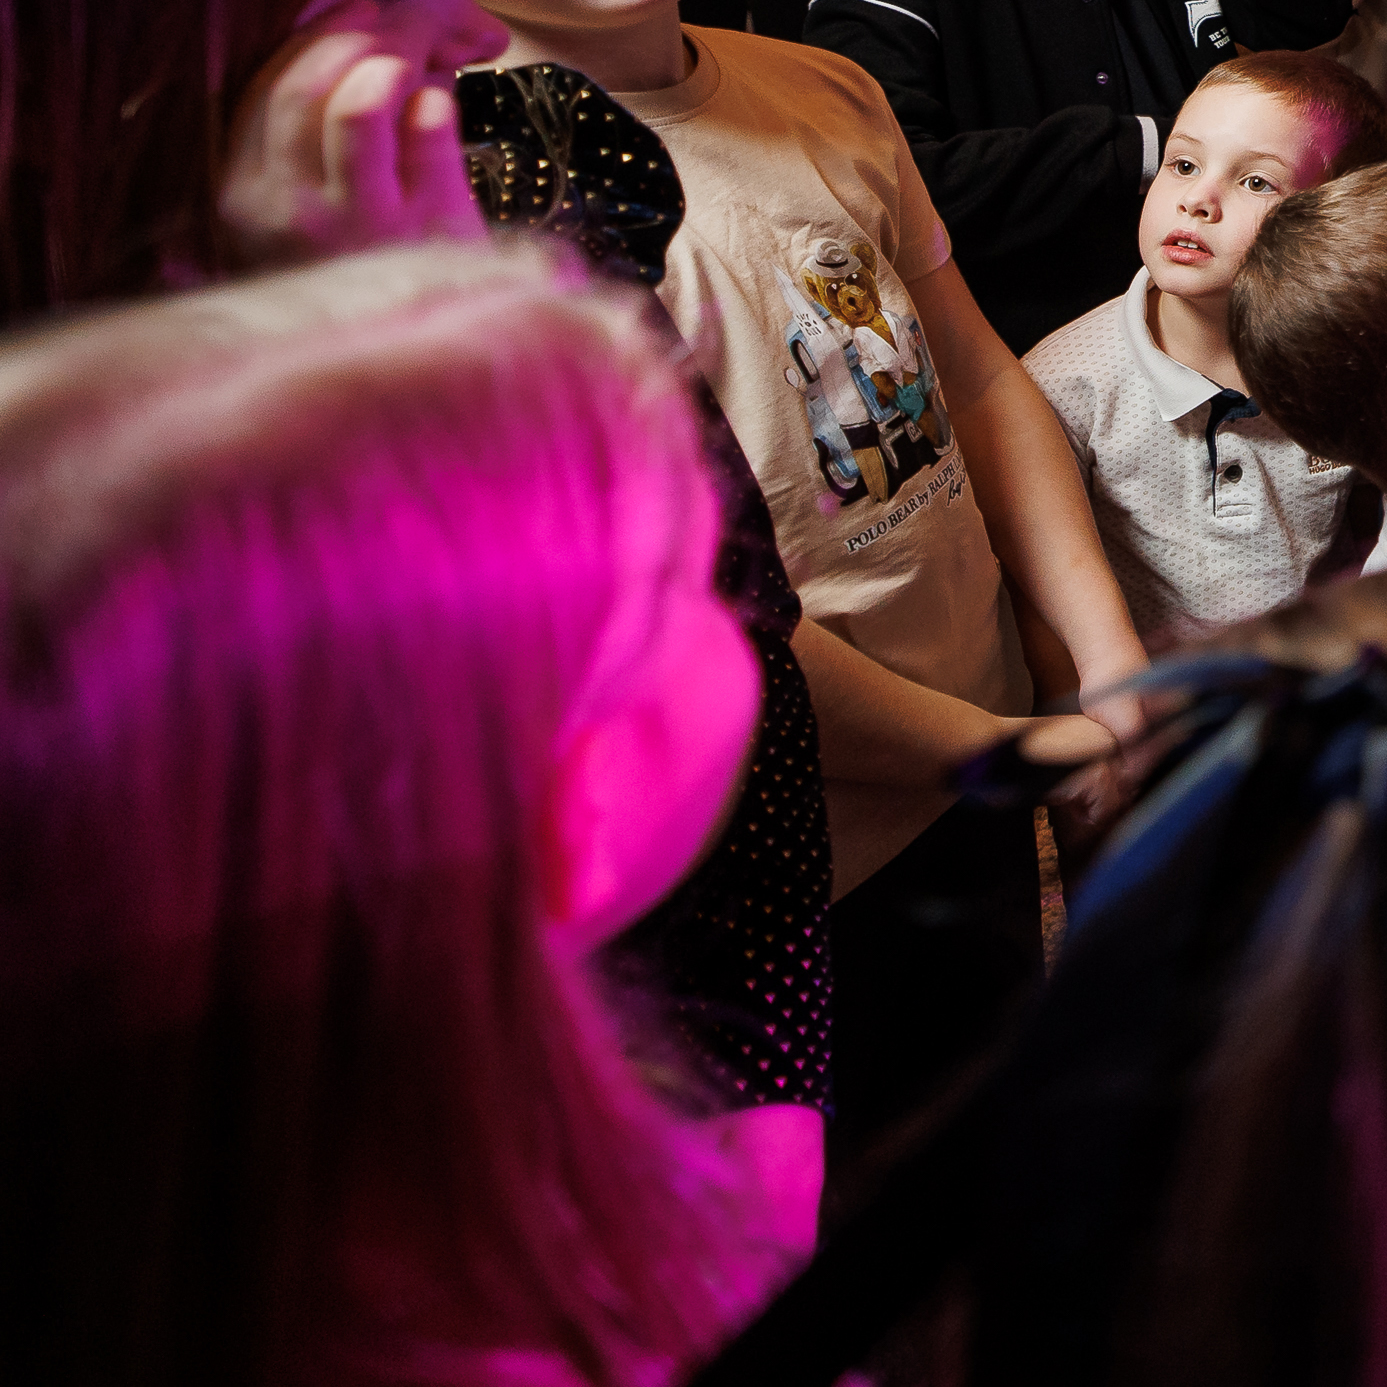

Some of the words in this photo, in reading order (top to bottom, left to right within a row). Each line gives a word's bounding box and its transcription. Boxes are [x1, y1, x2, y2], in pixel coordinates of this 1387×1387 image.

[845, 521, 887, 553] POLO
[887, 499, 919, 528] BEAR
[917, 491, 931, 506] by
[927, 463, 956, 496] RALPH
